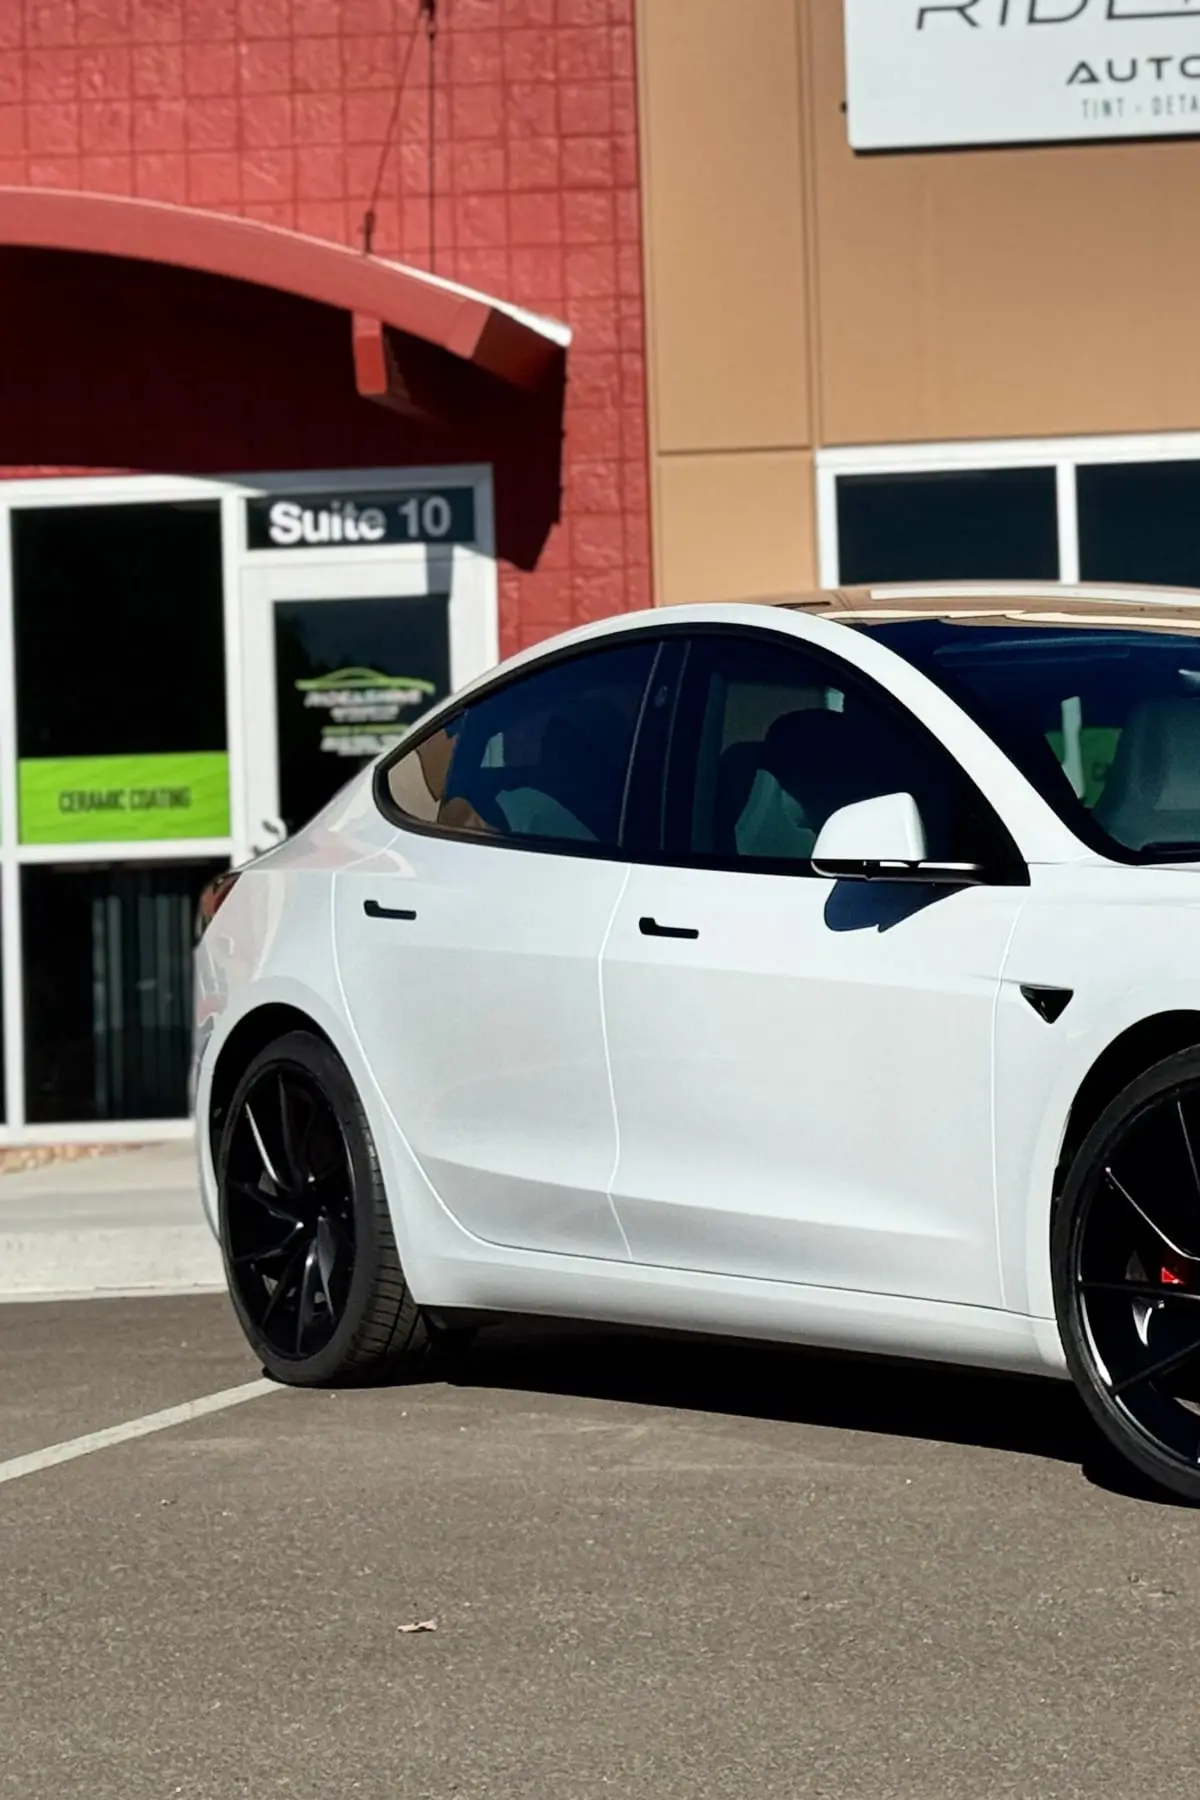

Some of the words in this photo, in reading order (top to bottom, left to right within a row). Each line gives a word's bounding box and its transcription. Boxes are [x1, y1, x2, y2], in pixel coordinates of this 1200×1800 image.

[1082, 96, 1124, 119] TINT
[269, 501, 386, 545] Suite
[398, 496, 452, 538] 10
[59, 788, 125, 815] CERAMIC
[130, 786, 192, 812] COATING
